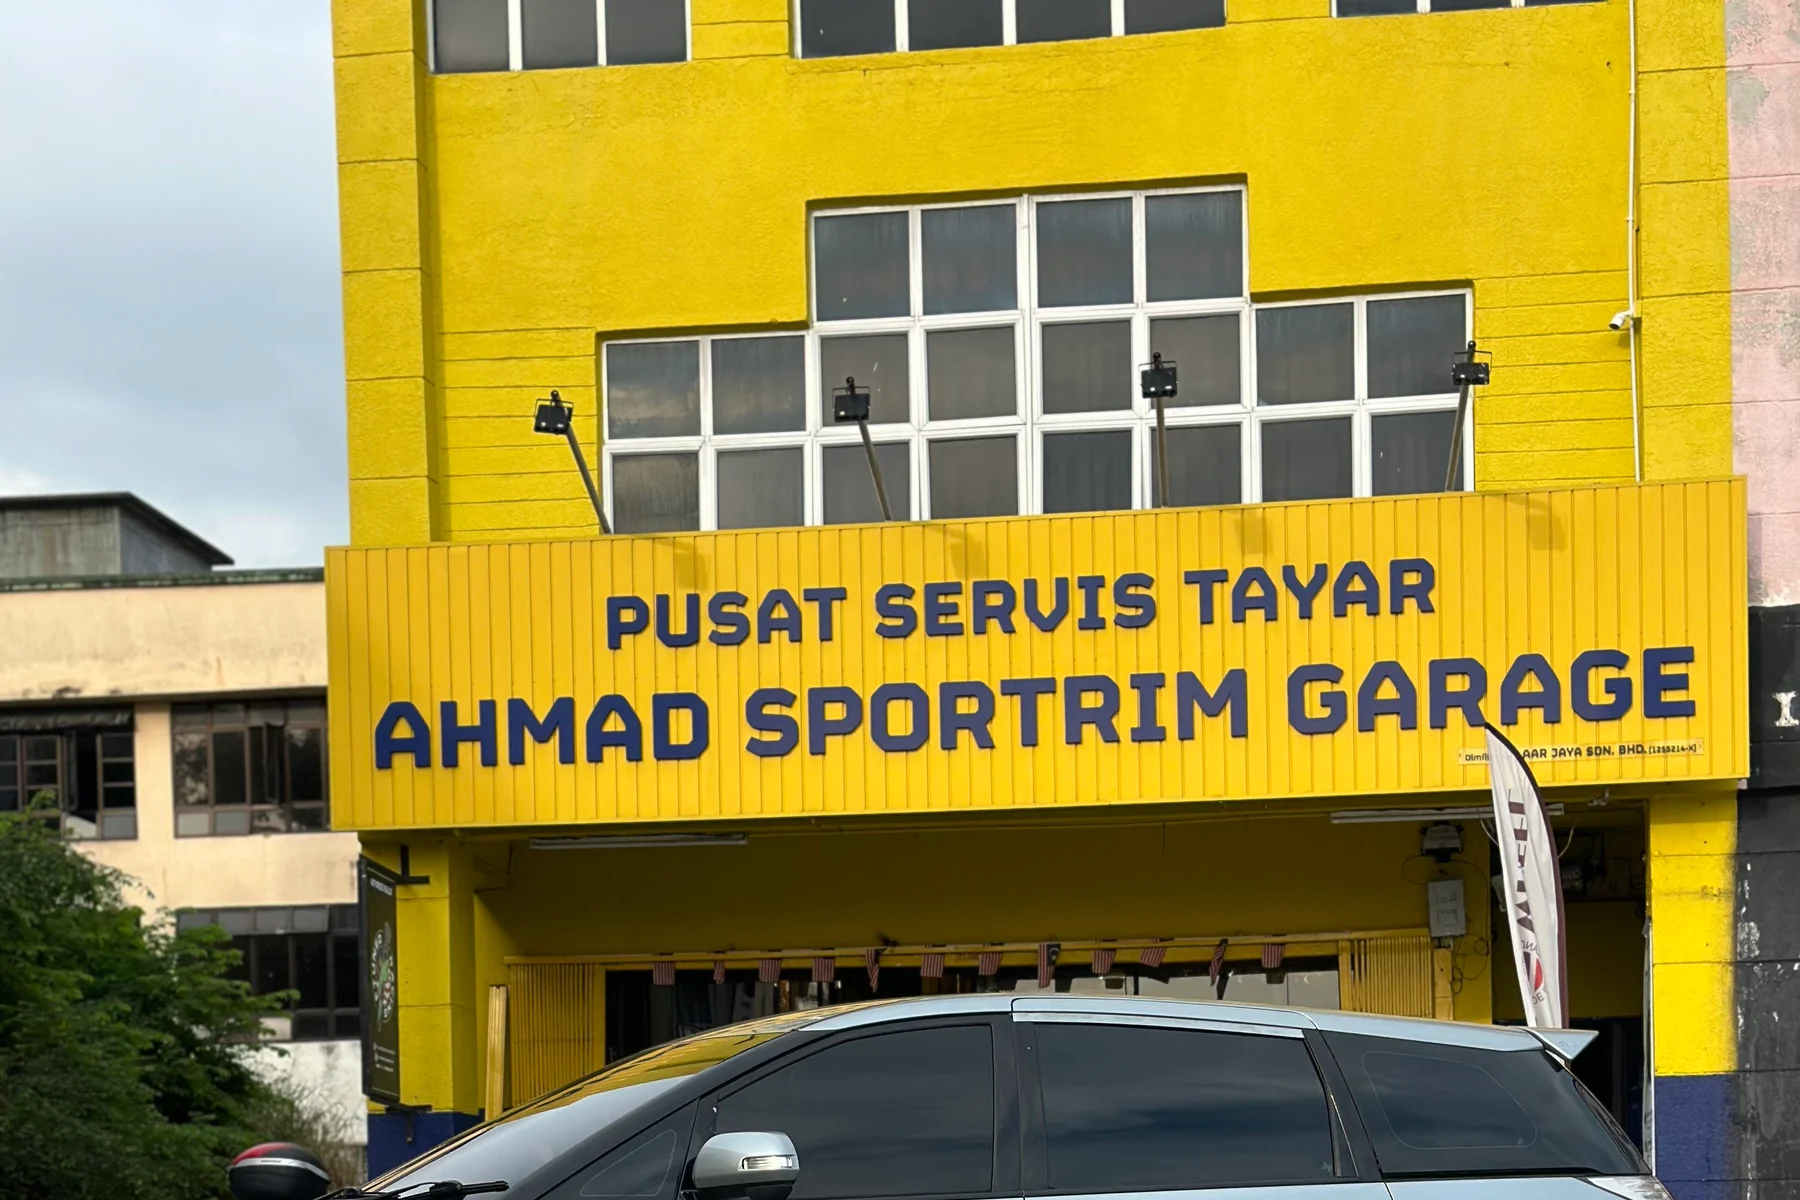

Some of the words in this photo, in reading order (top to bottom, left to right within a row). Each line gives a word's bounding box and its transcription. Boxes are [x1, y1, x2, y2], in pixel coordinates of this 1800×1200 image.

[607, 585, 845, 649] PUSAT
[876, 575, 1155, 637] SERVIS
[1185, 559, 1435, 624] TAYAR
[375, 693, 709, 769] AHMAD
[746, 670, 1247, 757] SPORTRIM
[1287, 646, 1695, 735] GARAGE
[1551, 746, 1583, 758] JAYA
[1586, 745, 1614, 757] SDN.
[1618, 743, 1647, 756] BHD.
